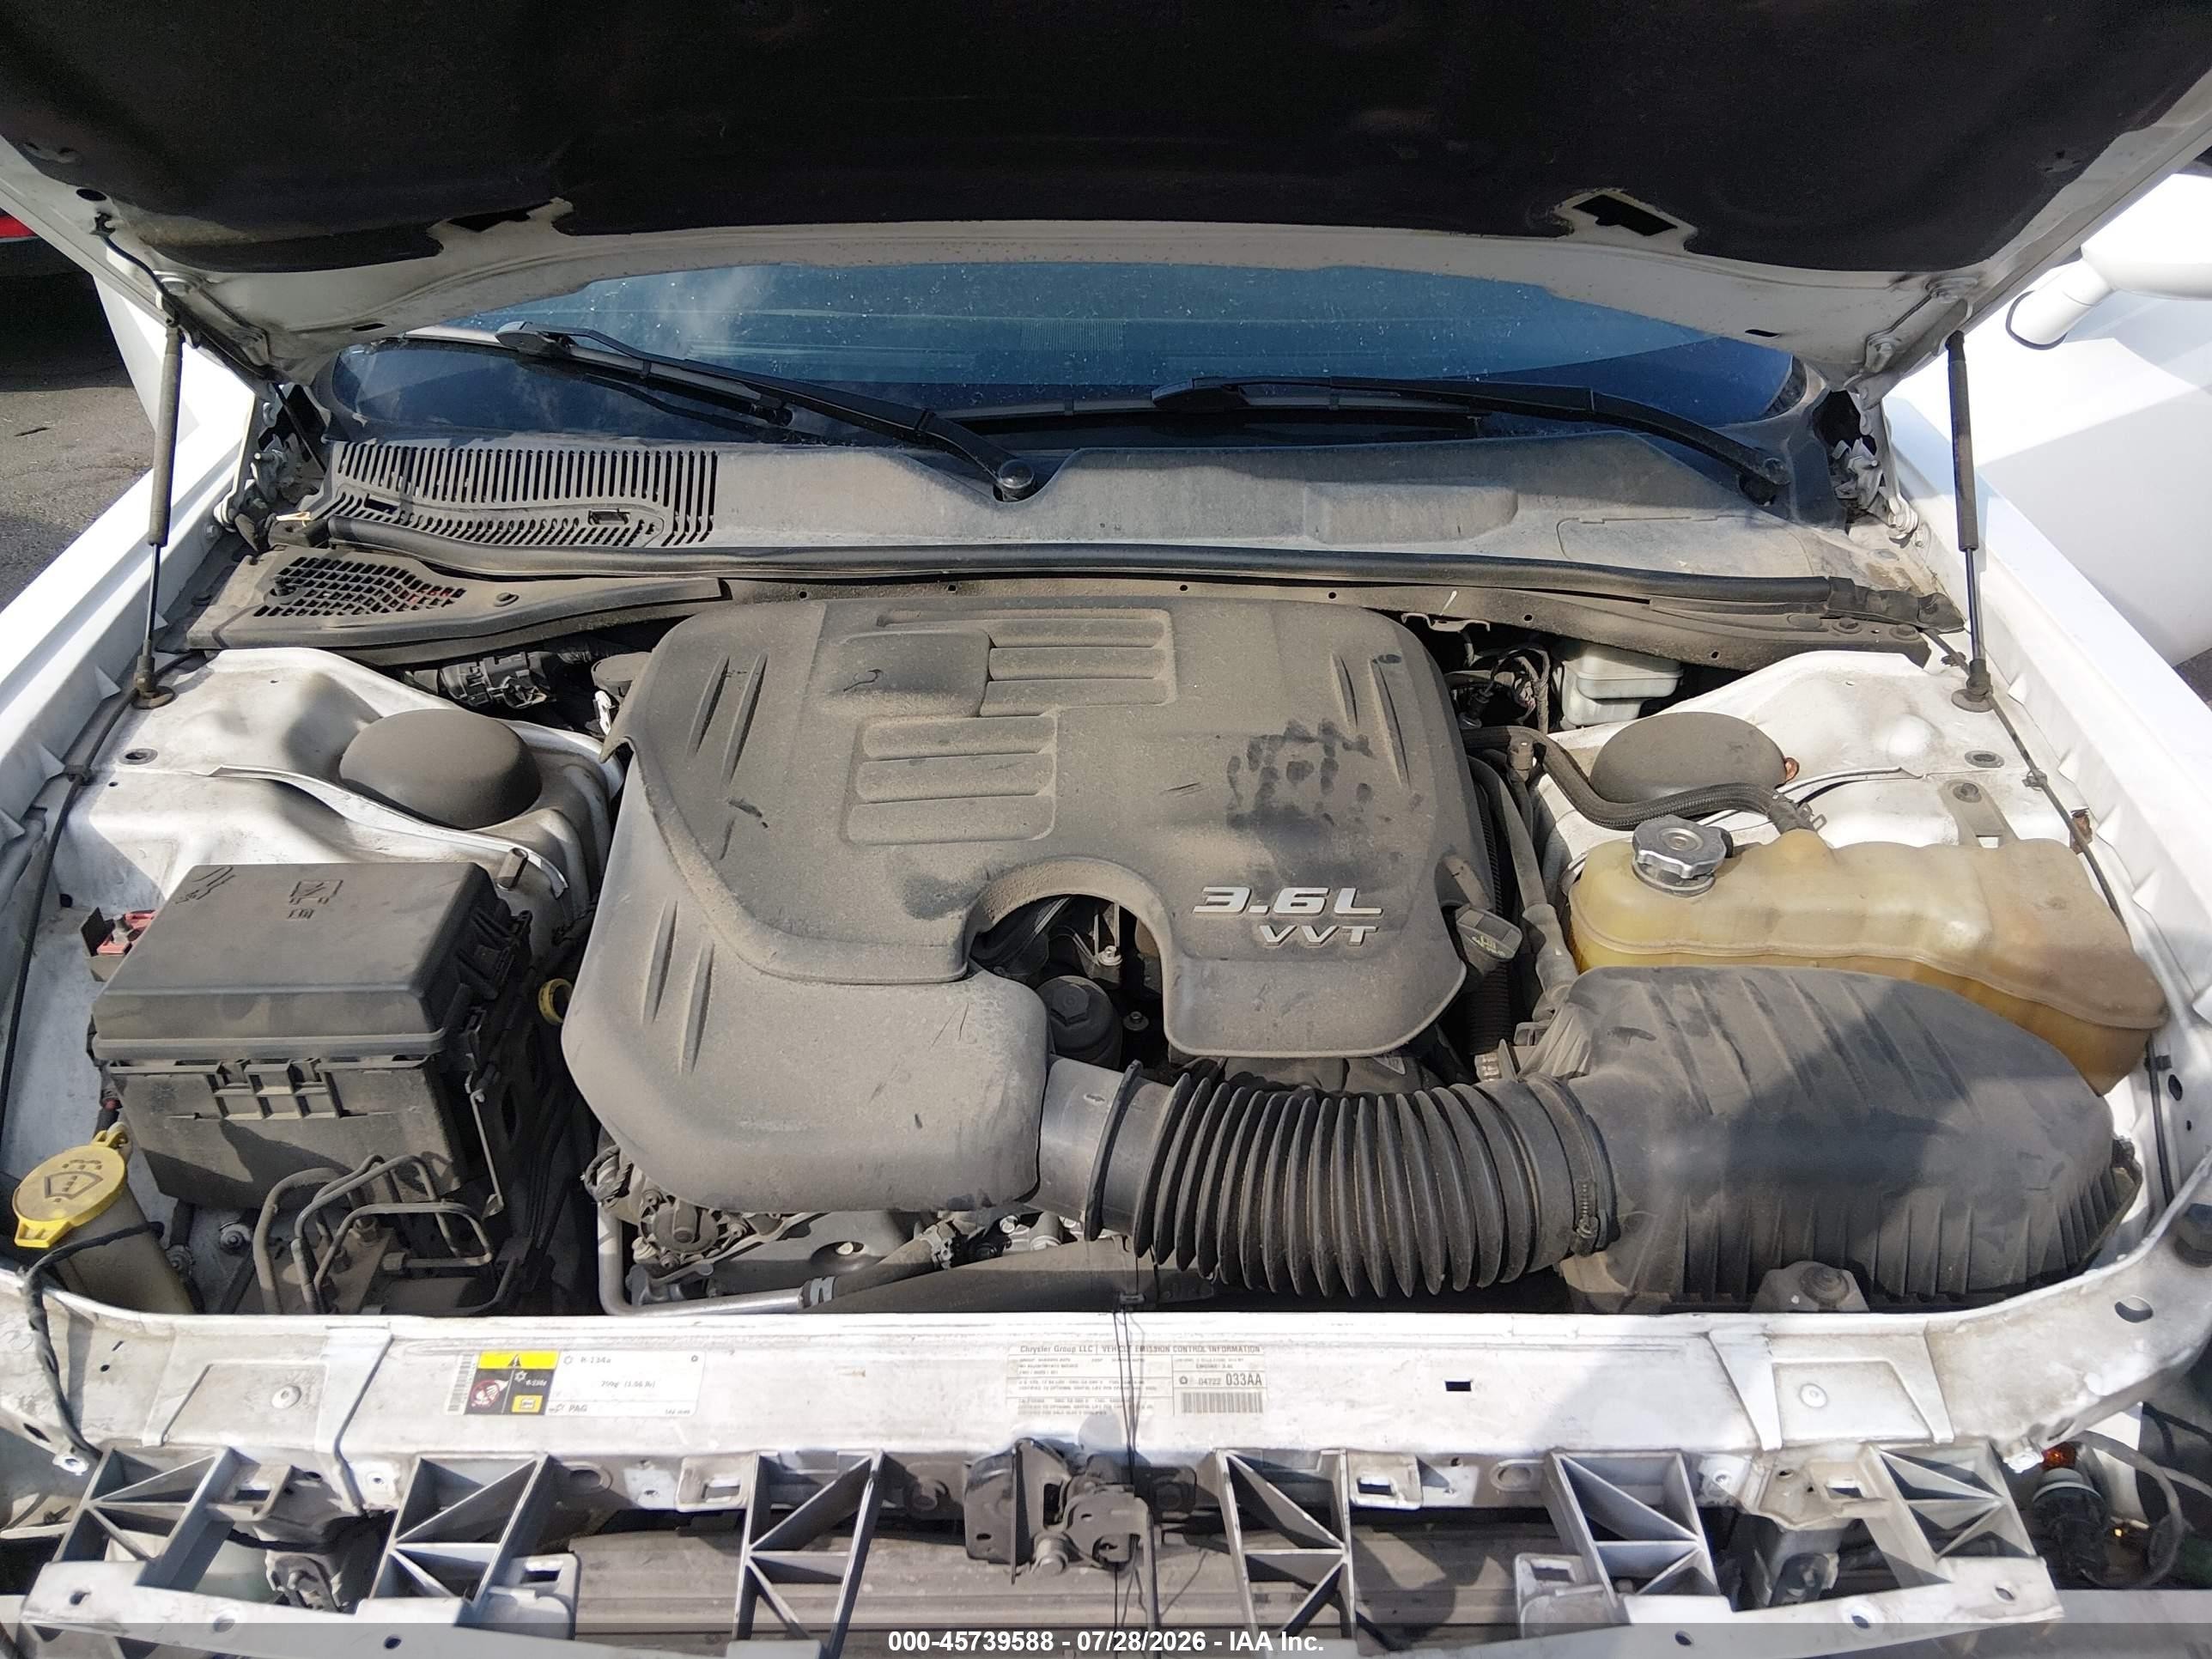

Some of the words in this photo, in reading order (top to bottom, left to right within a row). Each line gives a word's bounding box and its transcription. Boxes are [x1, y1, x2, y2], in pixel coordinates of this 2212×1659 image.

[1193, 886, 1383, 916] 3.6L
[1259, 925, 1379, 946] VVT
[1019, 1345, 1051, 1354] Chrysler
[1054, 1345, 1077, 1354] Group
[1079, 1345, 1094, 1353] LLC
[1172, 1345, 1206, 1353] CONTROL
[1208, 1345, 1261, 1353] INFORMATION
[1225, 1372, 1262, 1386] 033AA
